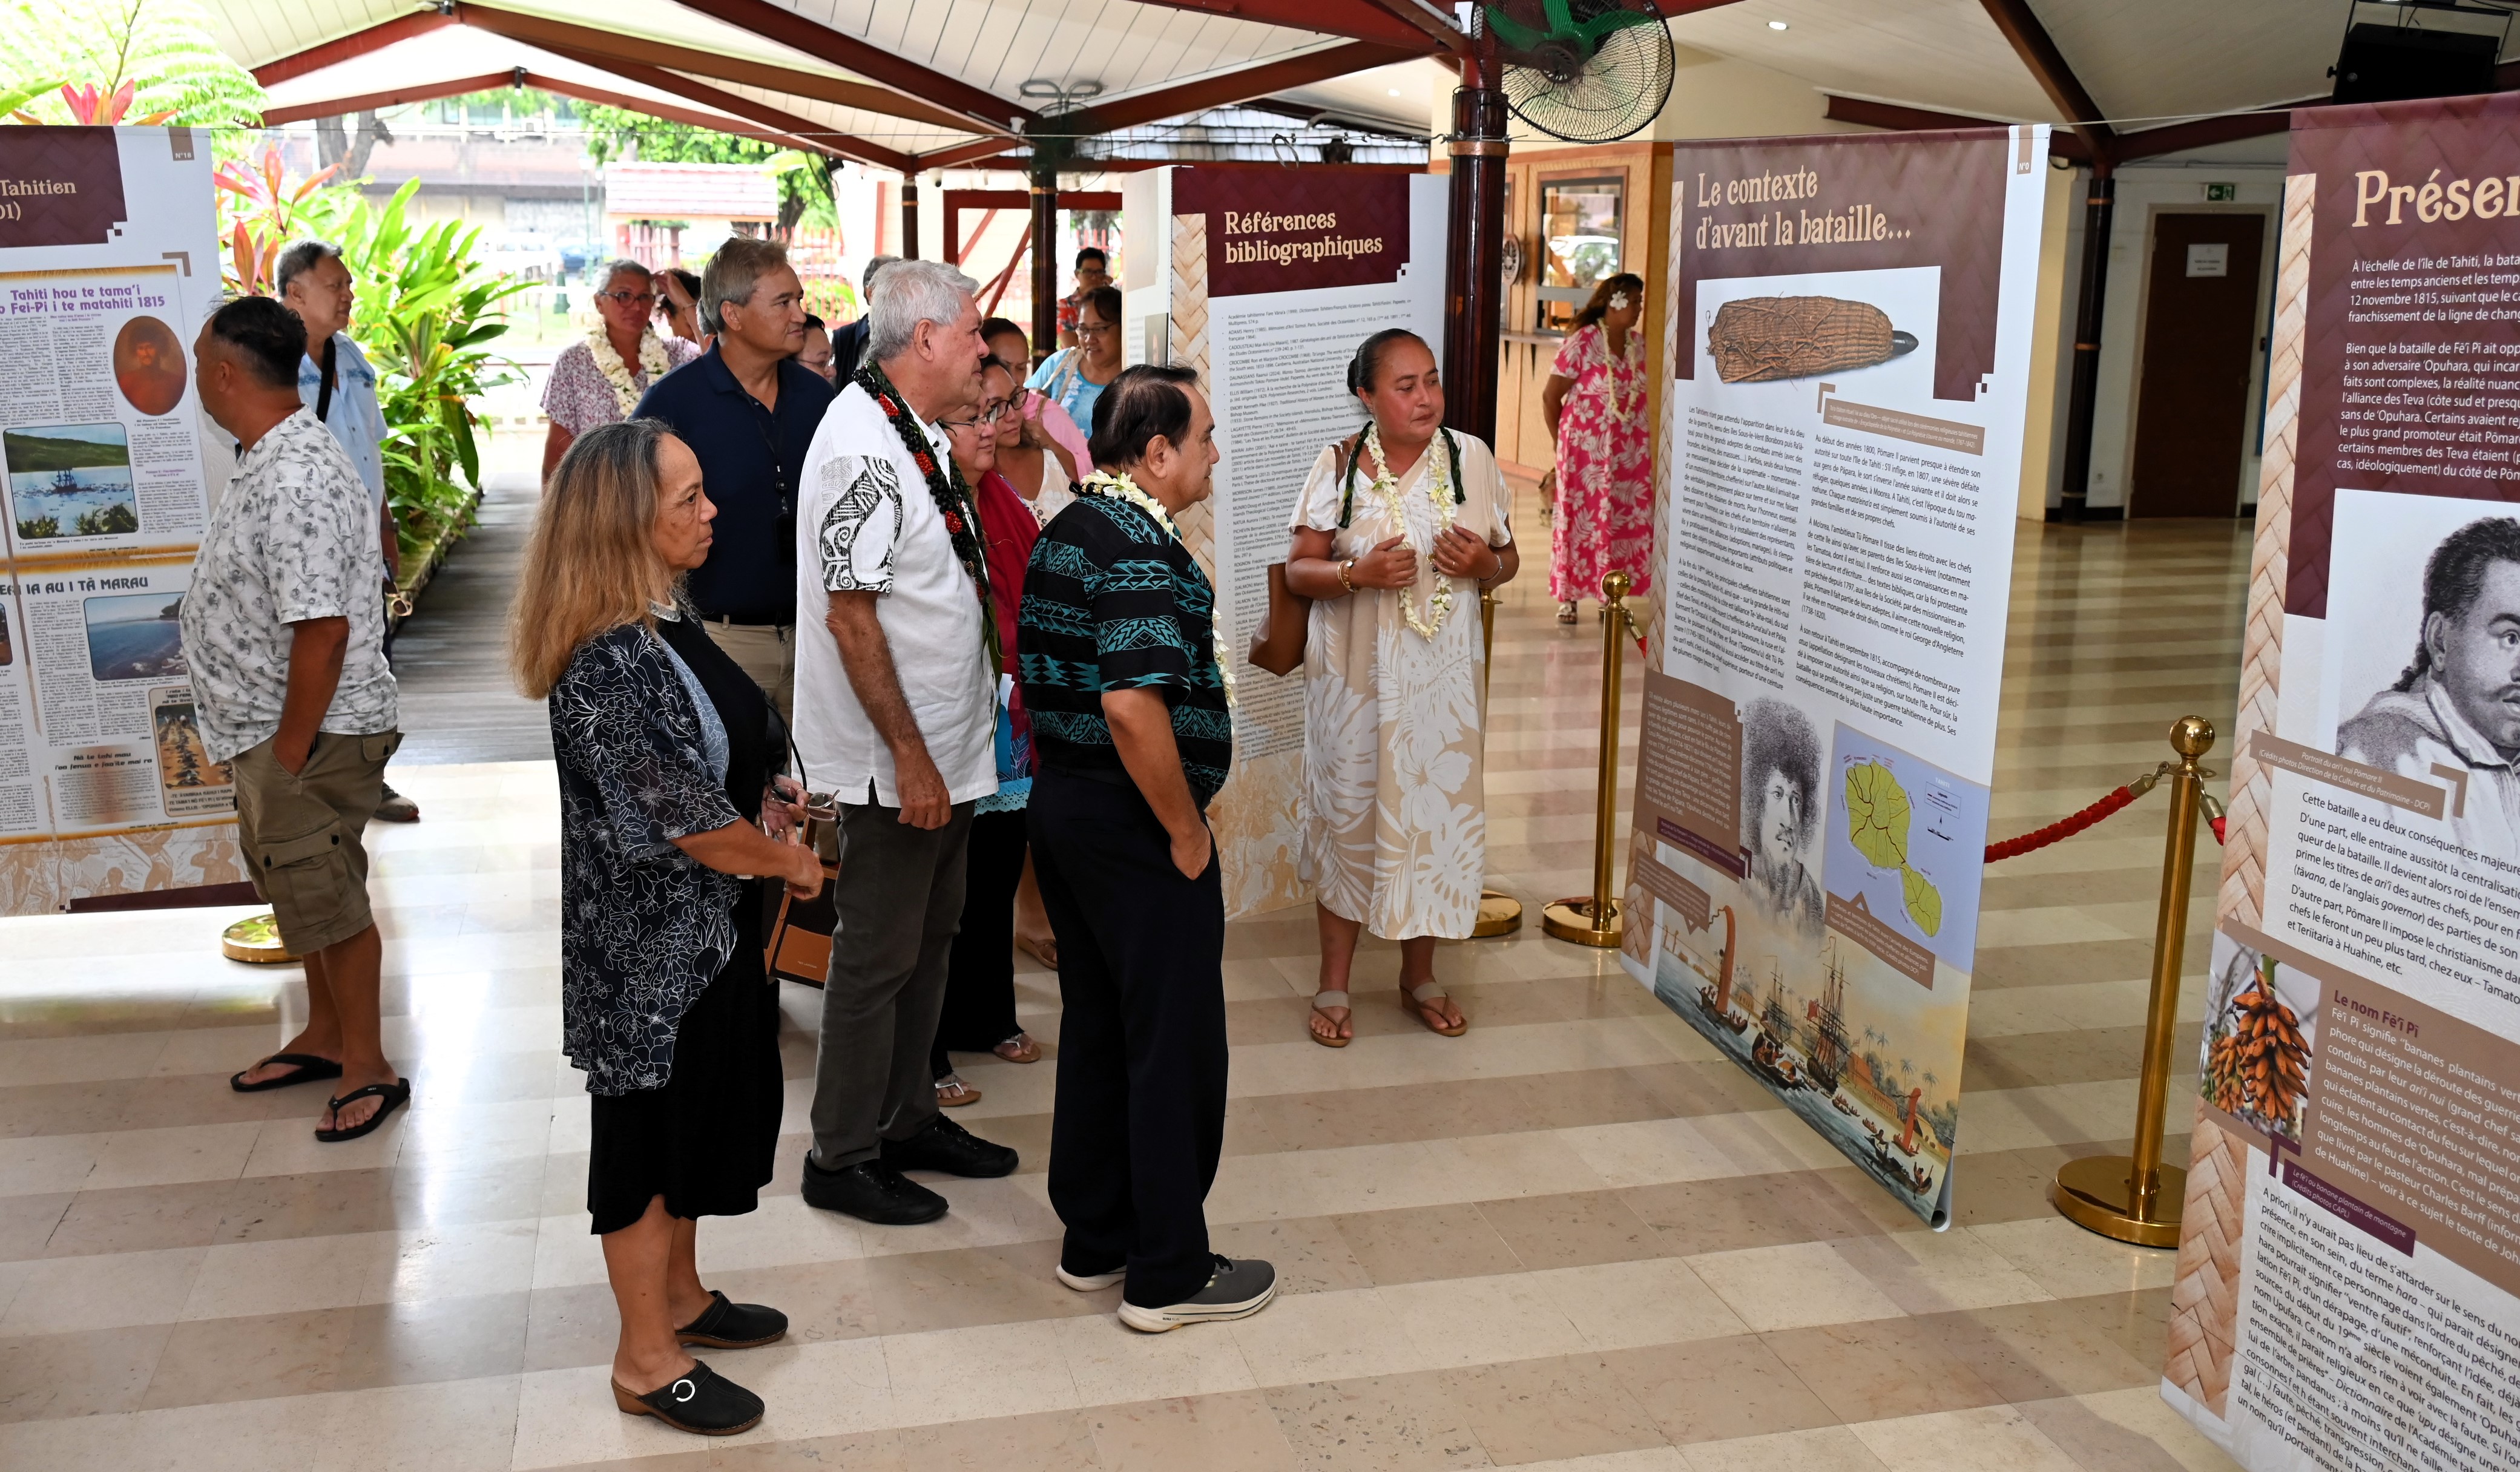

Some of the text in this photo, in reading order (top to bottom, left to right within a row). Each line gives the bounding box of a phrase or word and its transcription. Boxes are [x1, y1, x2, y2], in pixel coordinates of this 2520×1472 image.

[0, 179, 77, 196] Tahitien
[1697, 165, 1818, 208] Le contexte
[1224, 211, 1336, 234] Références
[1696, 204, 1910, 249] d'avant la bataille...
[1225, 235, 1383, 266] bibliographiques
[2352, 254, 2493, 272] À l'échelle de l'île de Tahiti, la
[2351, 272, 2489, 290] entre les temps anciens et les
[10, 288, 48, 301] Tahiti
[53, 288, 77, 299] hou
[82, 288, 94, 298] te
[2351, 289, 2511, 306] 12 novembre 1815, suivant que le
[0, 296, 165, 315] o Fei-Pi i te matahiti 1815
[2349, 308, 2489, 324] franchissement de la ligne de
[2346, 343, 2366, 354] Bien
[2368, 345, 2386, 356] que
[2389, 342, 2397, 353] la
[2399, 342, 2436, 354] bataille
[2438, 342, 2452, 354] de
[2483, 343, 2497, 354] ait
[1815, 434, 1821, 442] Au
[1822, 436, 1835, 445] début
[1836, 439, 1844, 447] des
[1846, 442, 1862, 452] années
[1864, 445, 1876, 456] 1800,
[1900, 455, 1920, 465] parvient
[1921, 459, 1943, 470] presque
[1944, 462, 1947, 471] à
[1949, 464, 1970, 476] étendre
[1833, 464, 1839, 473] de
[1858, 470, 1862, 478] le
[1911, 485, 1933, 496] suivante
[1941, 490, 1945, 499] il
[1946, 491, 1956, 502] doit
[1958, 494, 1970, 505] alors
[26, 583, 41, 595] IA
[45, 582, 65, 594] AU
[69, 581, 74, 592] I
[100, 577, 148, 590] MARAU
[1795, 675, 1904, 727] conséquences seront de la plus haute importance.
[2301, 752, 2323, 765] Portrait
[2323, 759, 2331, 767] du
[1935, 777, 1950, 788] TAHITI
[2303, 792, 2478, 861] Cette bataille a eu deux conséquences
[2288, 921, 2403, 975] et Teriitaria à Huahine, etc.
[2334, 990, 2348, 1007] Le
[2351, 1000, 2379, 1020] nom
[2263, 1188, 2502, 1338] A priori, il n'y aurait pas lieu de s'attarder sur le sens du
